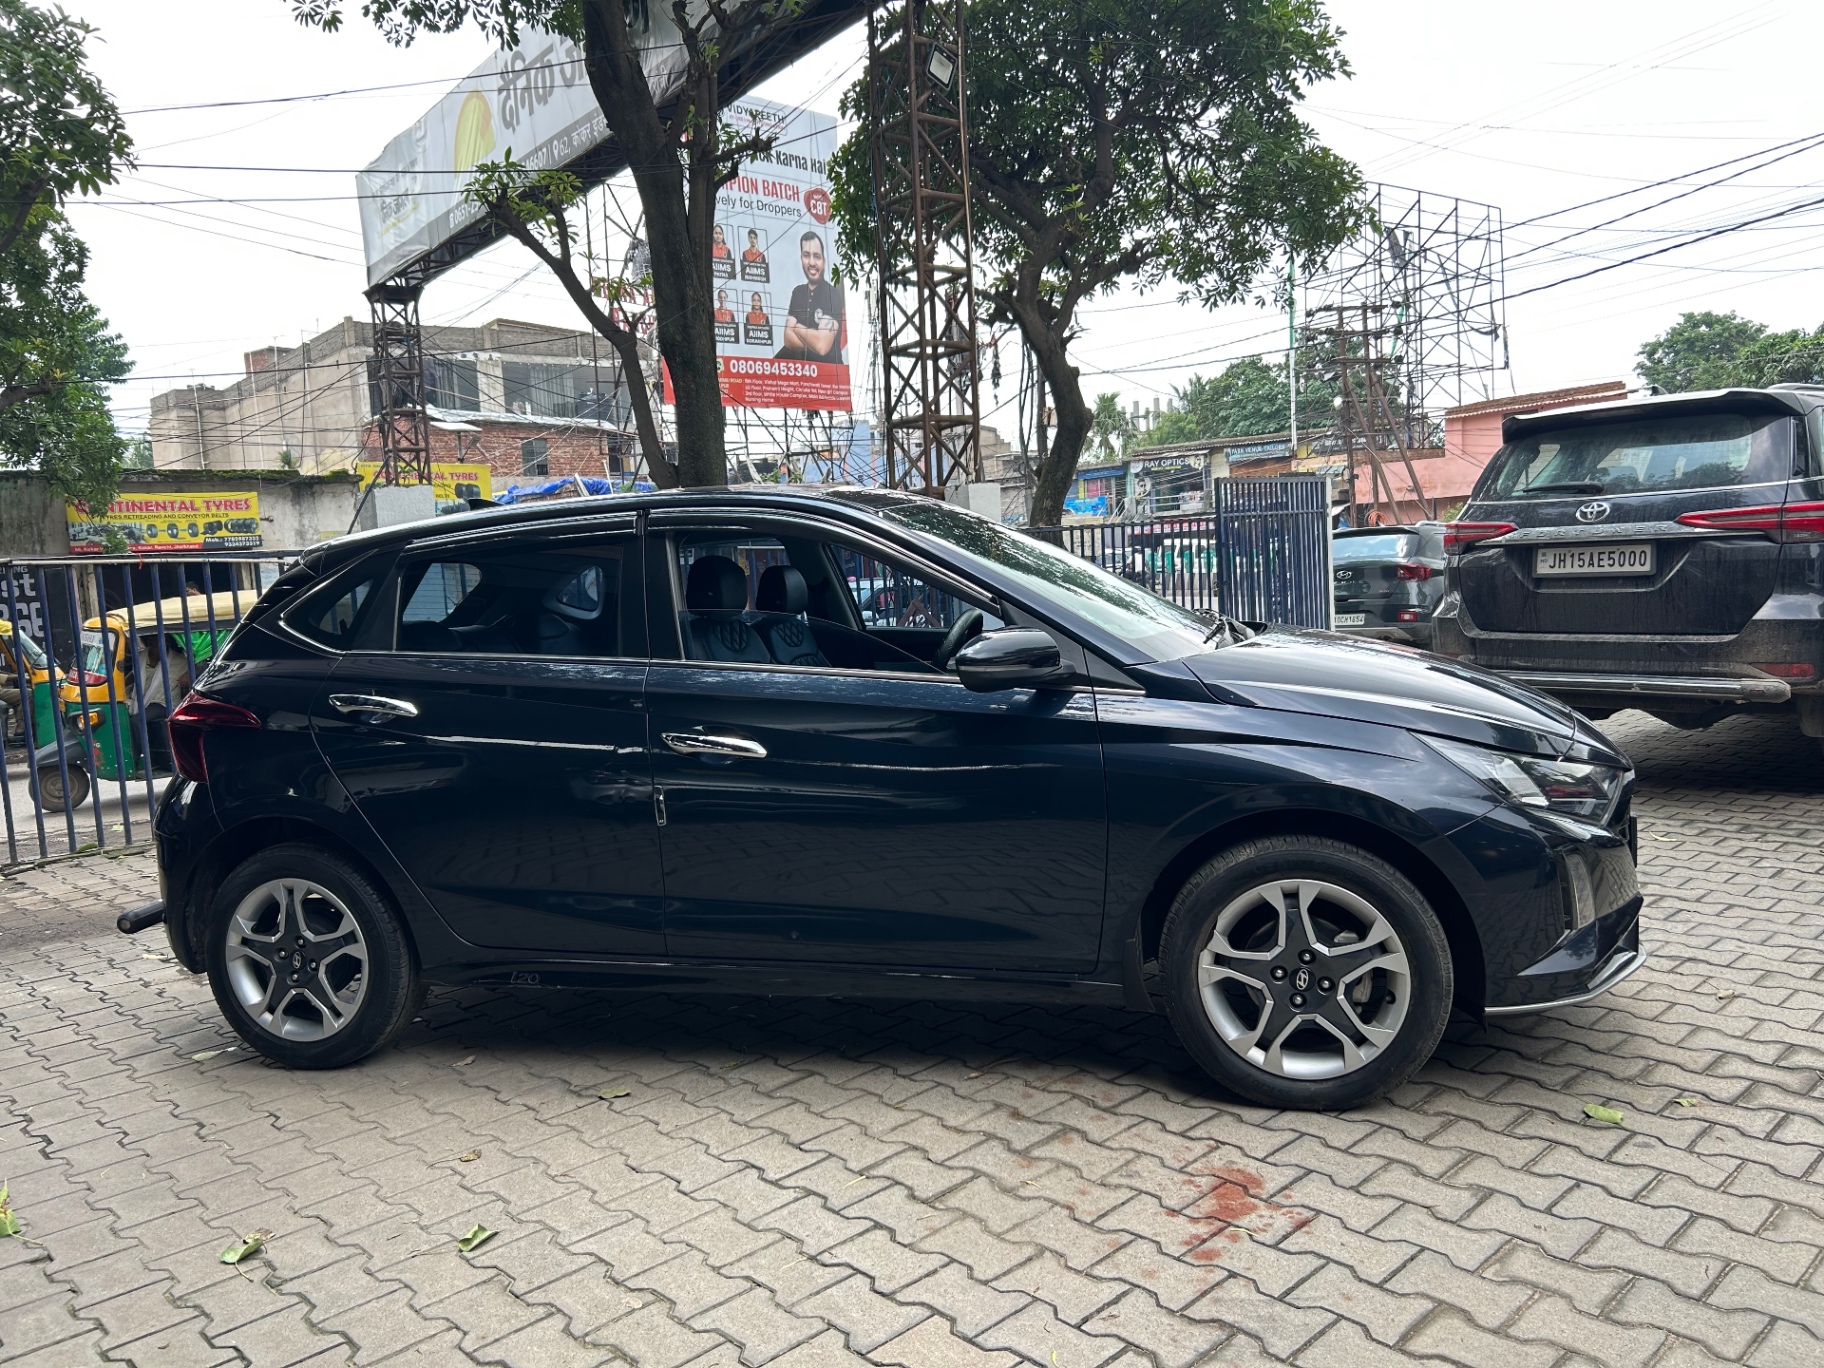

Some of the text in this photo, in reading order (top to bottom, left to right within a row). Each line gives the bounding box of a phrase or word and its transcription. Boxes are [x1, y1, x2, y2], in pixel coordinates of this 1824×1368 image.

[498, 42, 555, 134] दैनिक
[775, 149, 808, 172] Karna
[809, 157, 827, 175] Hai
[761, 178, 800, 202] BATCH
[740, 196, 753, 210] for
[756, 199, 802, 217] Droppers
[810, 199, 827, 216] CBT
[745, 266, 766, 276] AIIMS
[715, 327, 735, 336] AIIMS
[748, 330, 769, 339] AIIMS
[729, 359, 818, 377] 08069453340
[1144, 457, 1190, 468] RAY OPTICS
[449, 471, 479, 481] TYRES
[75, 498, 251, 515] CNTINENTAL TYRES
[1519, 525, 1668, 539] FORTUNER
[1548, 549, 1647, 569] JH15AE5000
